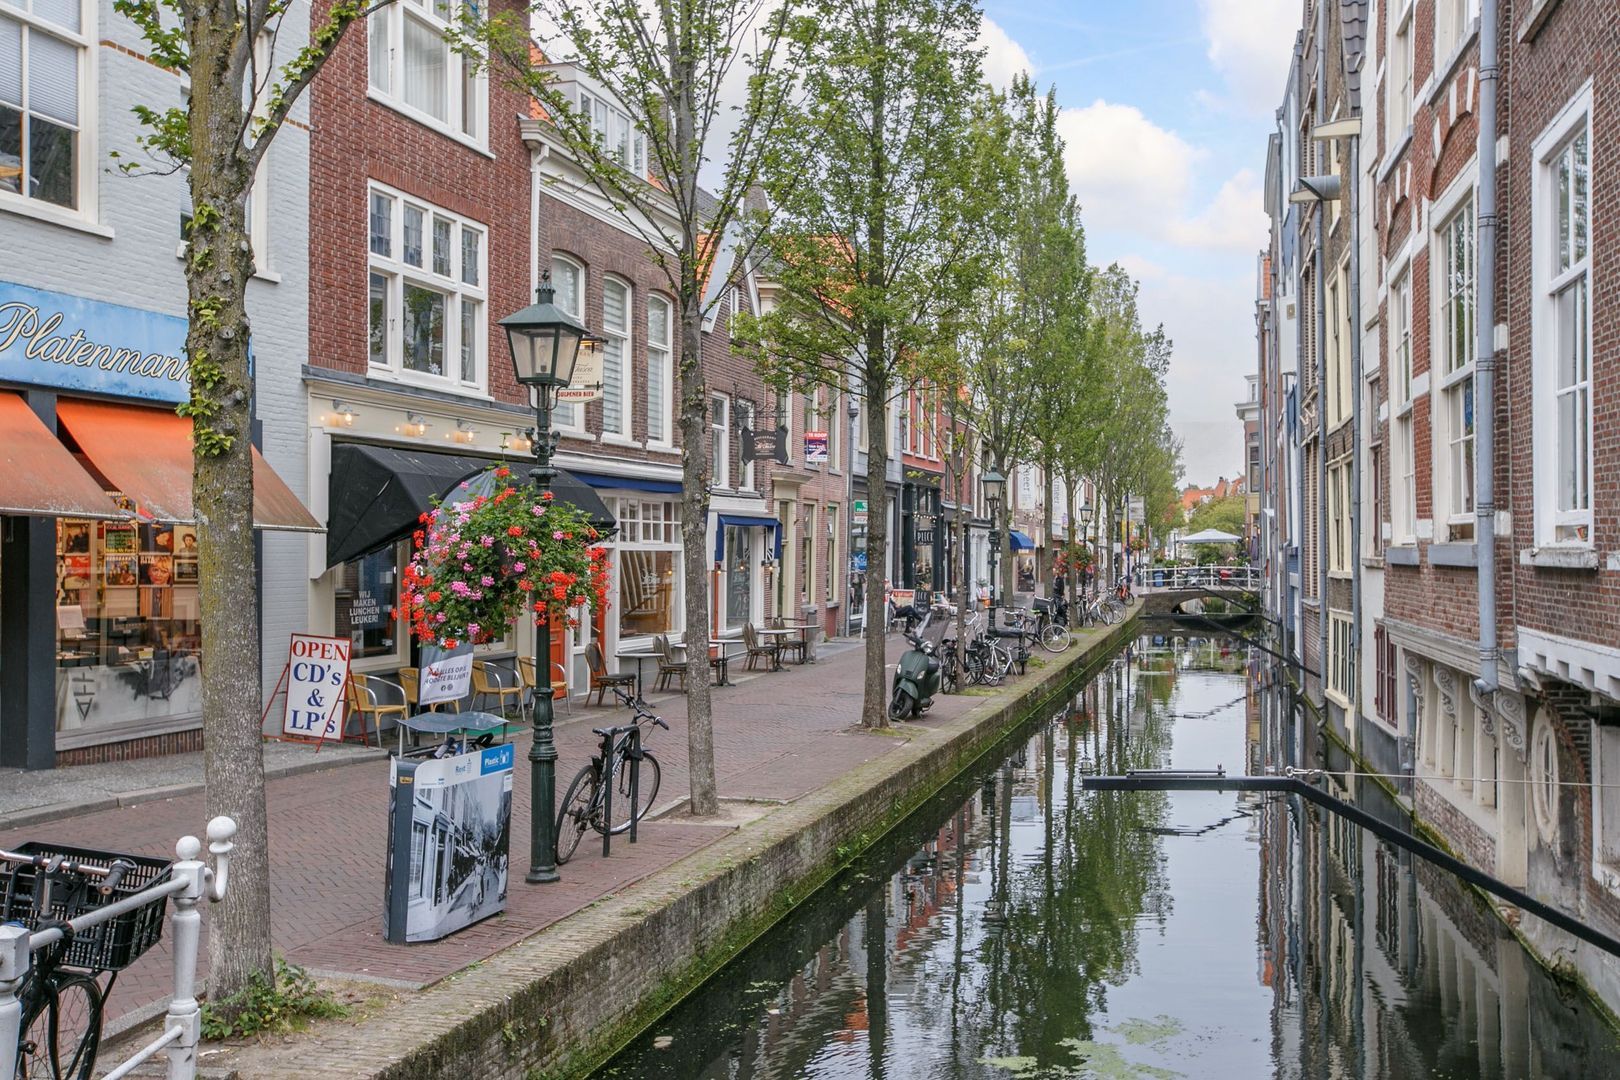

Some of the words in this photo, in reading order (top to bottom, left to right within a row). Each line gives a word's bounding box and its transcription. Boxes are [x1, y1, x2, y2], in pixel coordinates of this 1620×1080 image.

[358, 590, 371, 599] WIJ
[353, 598, 377, 608] MAKEN
[349, 606, 380, 617] LUNCHEN
[351, 615, 379, 625] LEUKER!
[292, 640, 348, 661] OPEN
[293, 662, 341, 686] CD's
[307, 688, 324, 707] &
